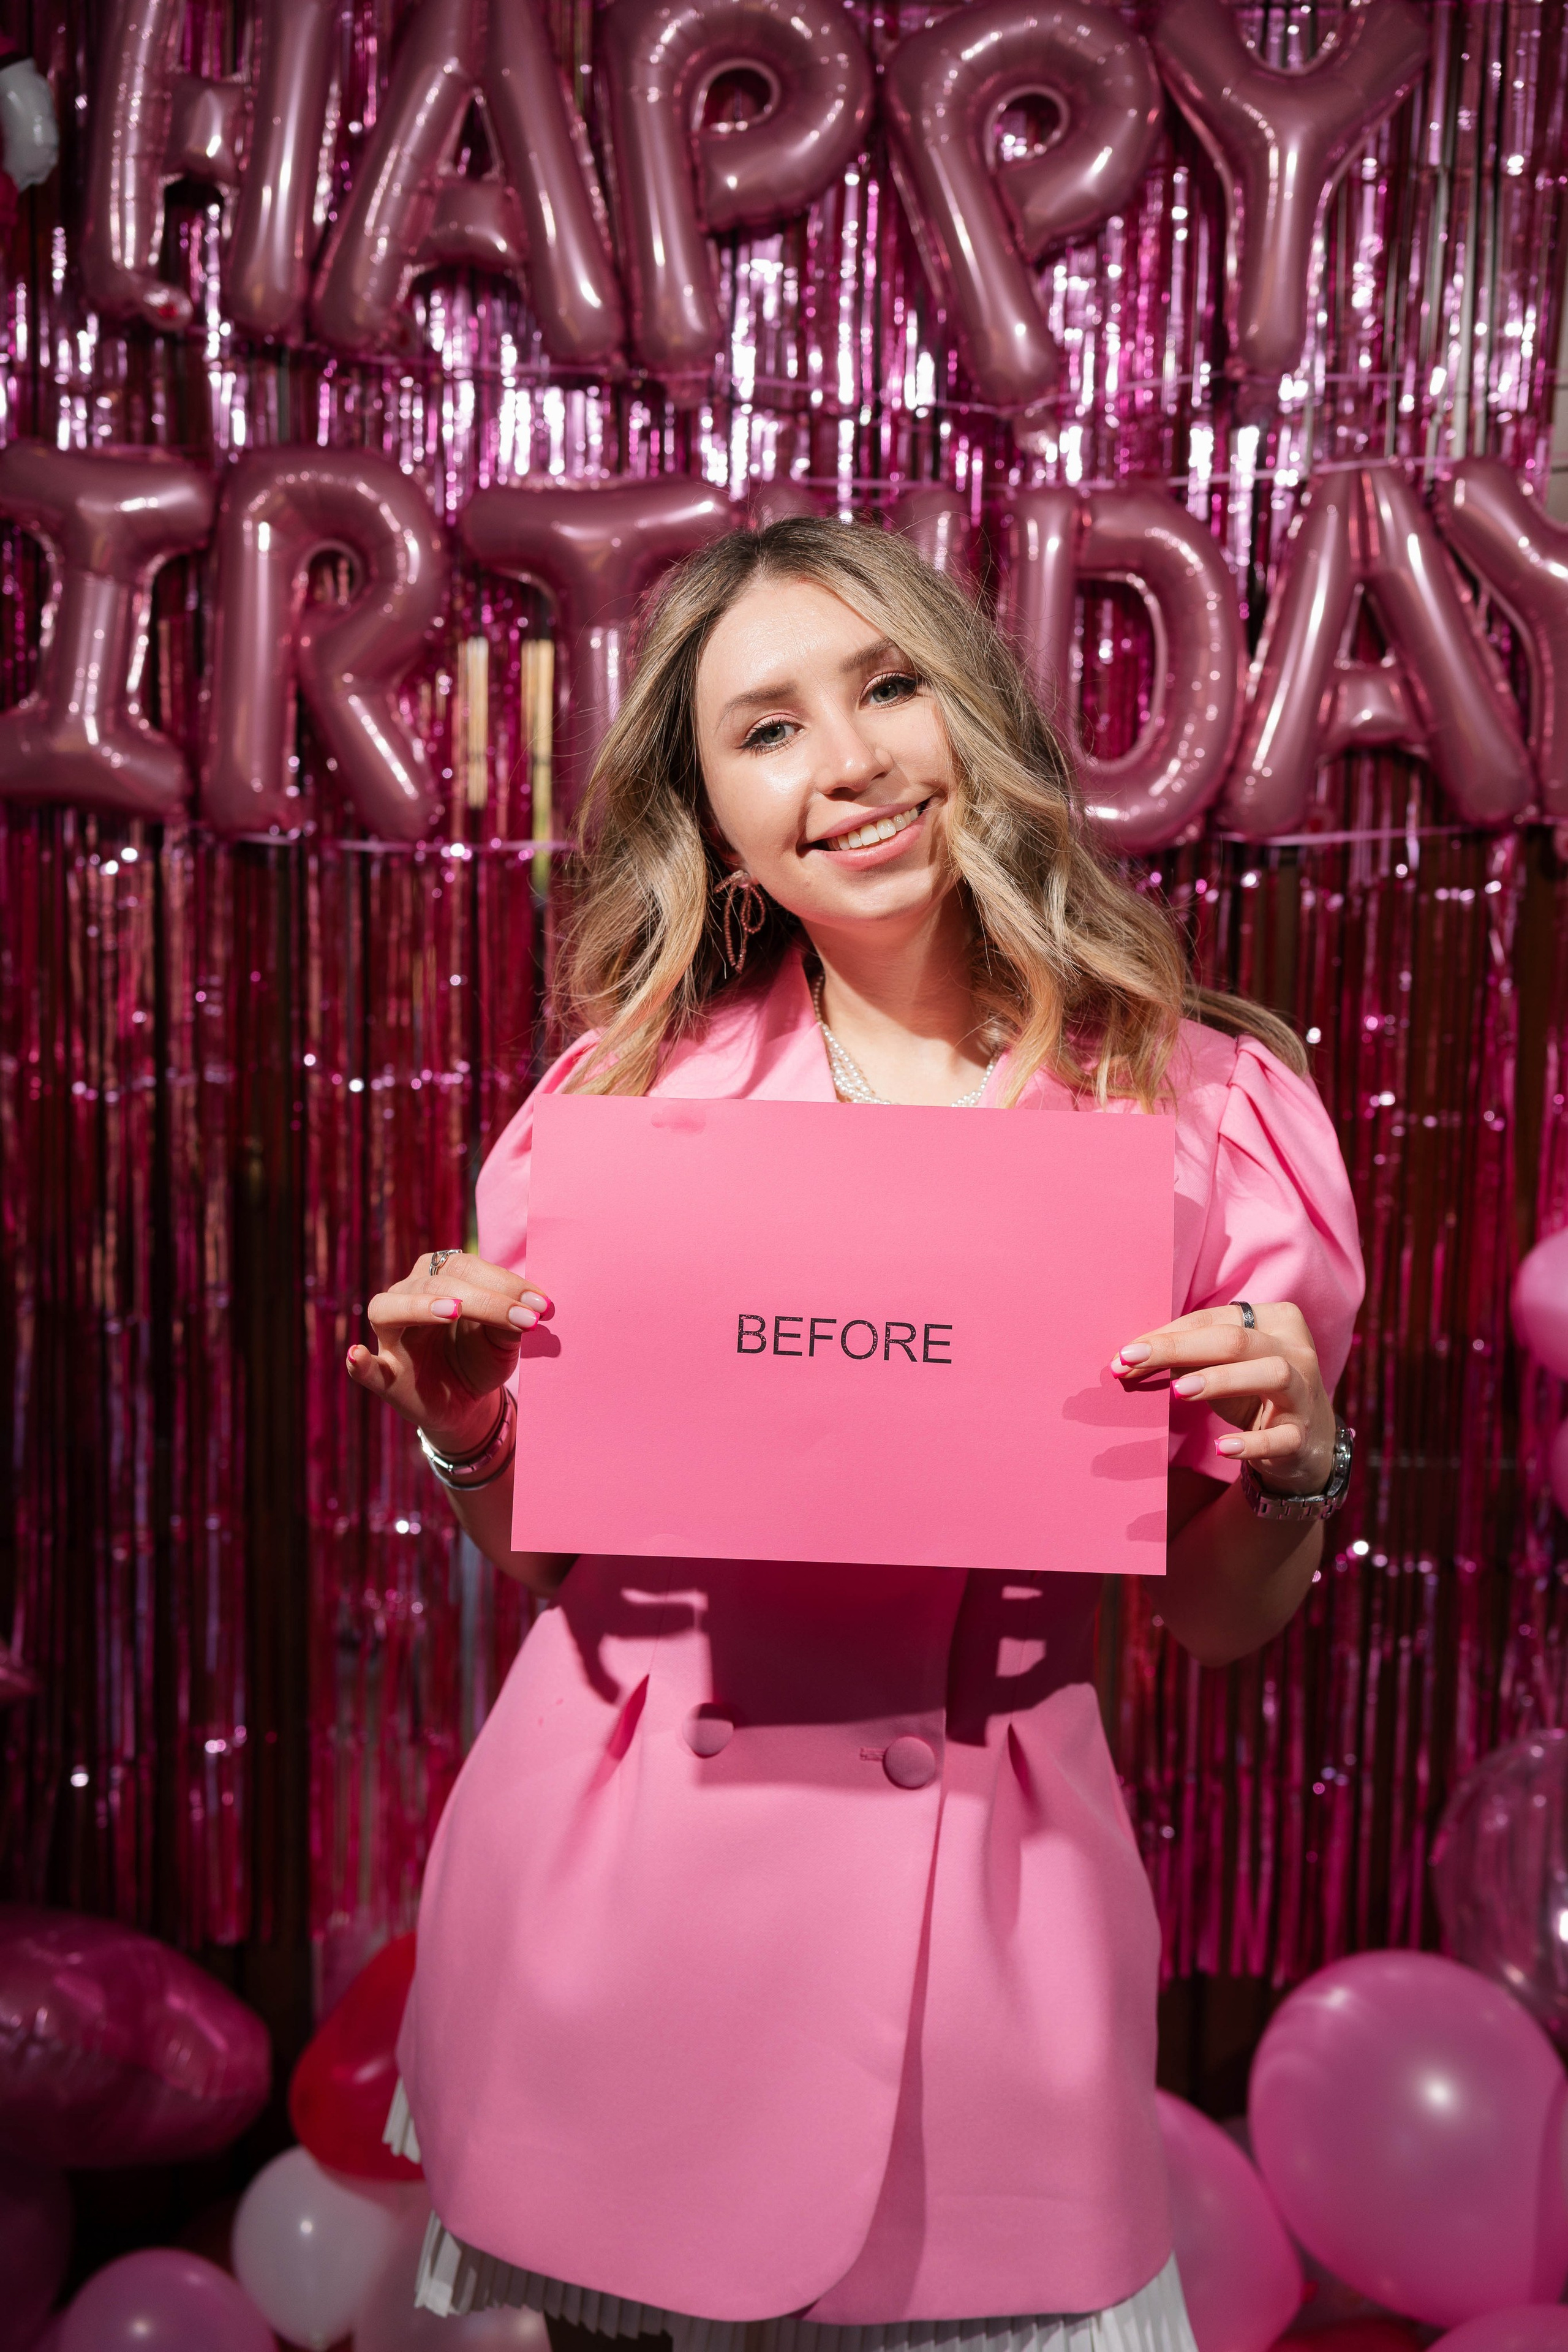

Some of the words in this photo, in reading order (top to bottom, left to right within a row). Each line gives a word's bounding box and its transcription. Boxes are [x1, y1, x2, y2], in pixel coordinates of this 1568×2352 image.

[83, 0, 1430, 407] HAPPY
[0, 447, 1568, 848] IRTDA
[736, 1314, 953, 1364] BEFORE
